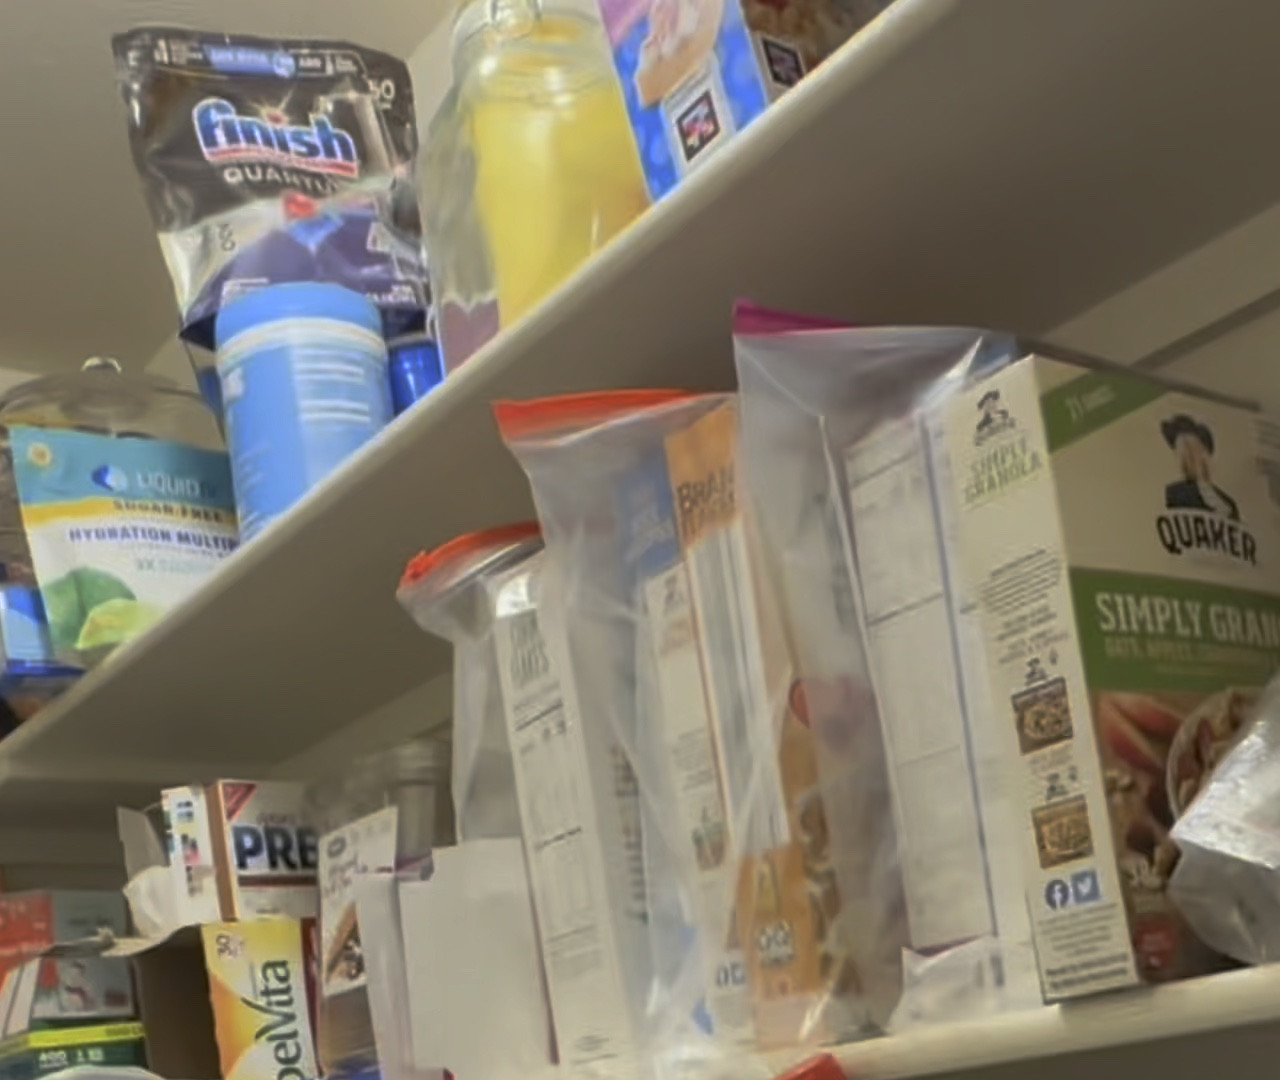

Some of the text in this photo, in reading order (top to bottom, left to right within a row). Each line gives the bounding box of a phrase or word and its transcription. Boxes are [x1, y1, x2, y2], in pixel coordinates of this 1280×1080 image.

[193, 97, 357, 163] finish
[134, 473, 201, 497] LIQUID
[1156, 514, 1257, 566] QUAKER
[1095, 592, 1204, 638] SIMPLY
